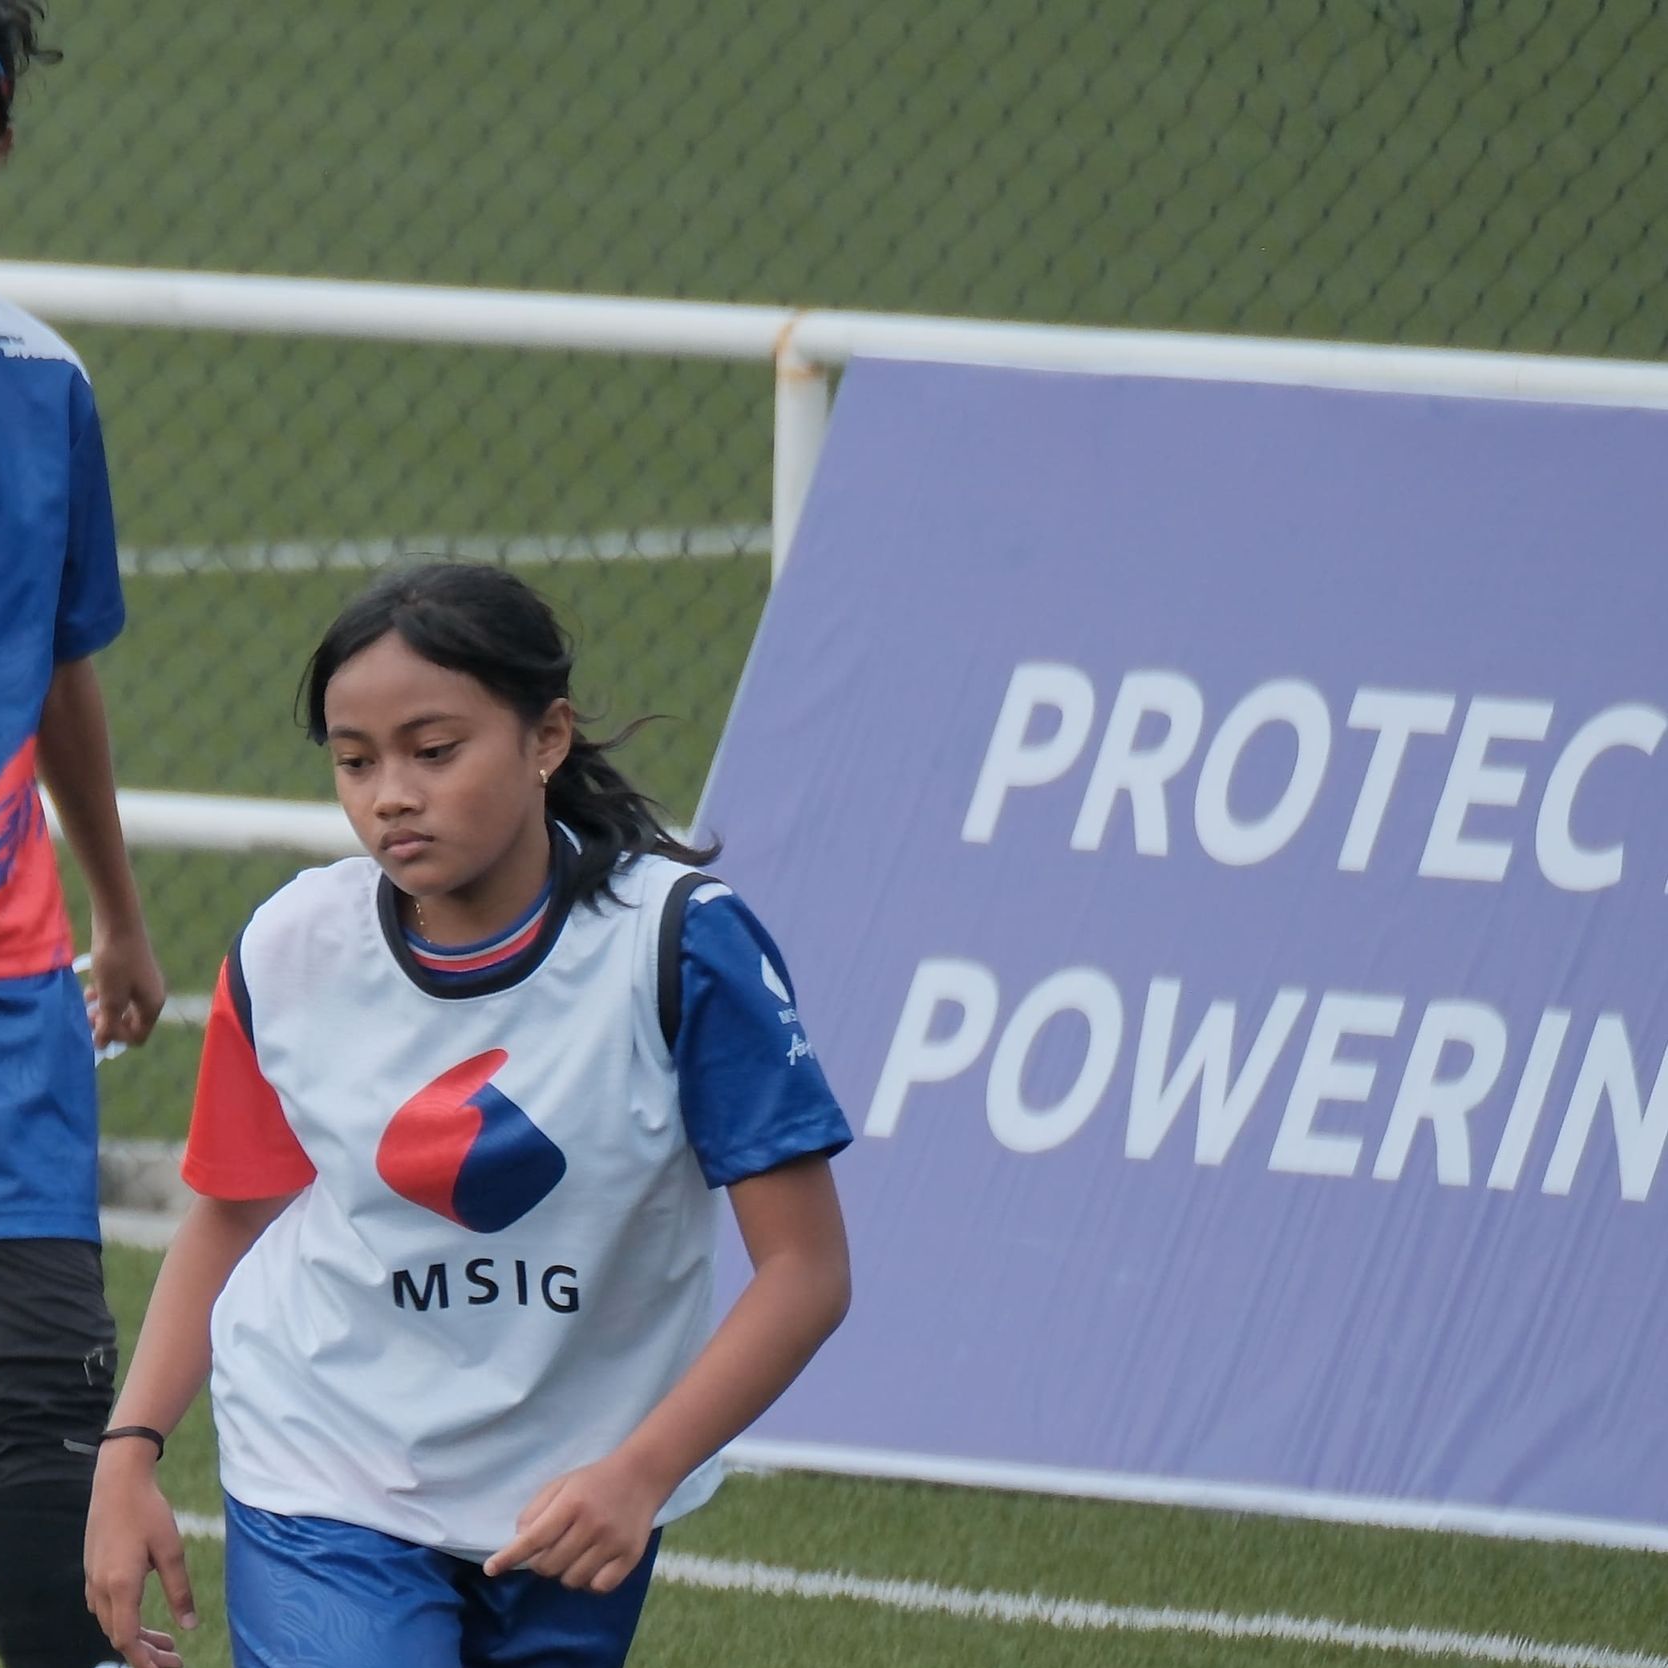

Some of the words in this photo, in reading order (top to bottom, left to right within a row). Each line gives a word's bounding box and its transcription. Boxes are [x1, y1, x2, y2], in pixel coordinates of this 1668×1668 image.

[960, 660, 1668, 892] PROTEC
[862, 956, 1668, 1202] POWERIN
[392, 1258, 579, 1314] MSIG
